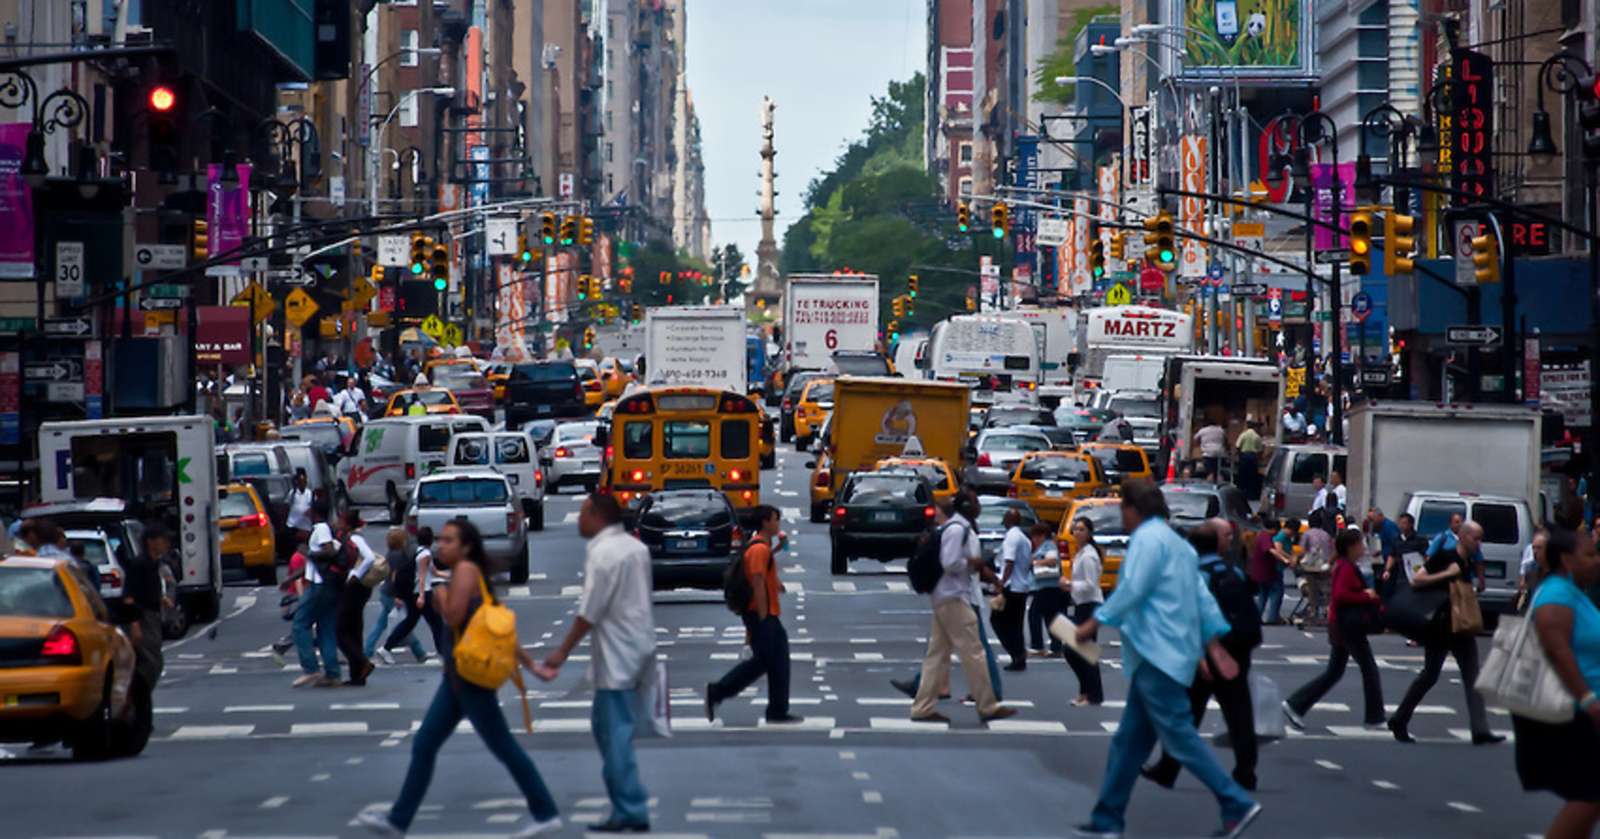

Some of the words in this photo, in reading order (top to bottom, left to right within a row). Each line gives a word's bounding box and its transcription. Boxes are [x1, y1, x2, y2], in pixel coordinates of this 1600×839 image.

[59, 264, 80, 281] 30
[813, 300, 868, 309] TRUCKING
[1104, 320, 1176, 337] MARTZ
[824, 329, 838, 349] 6
